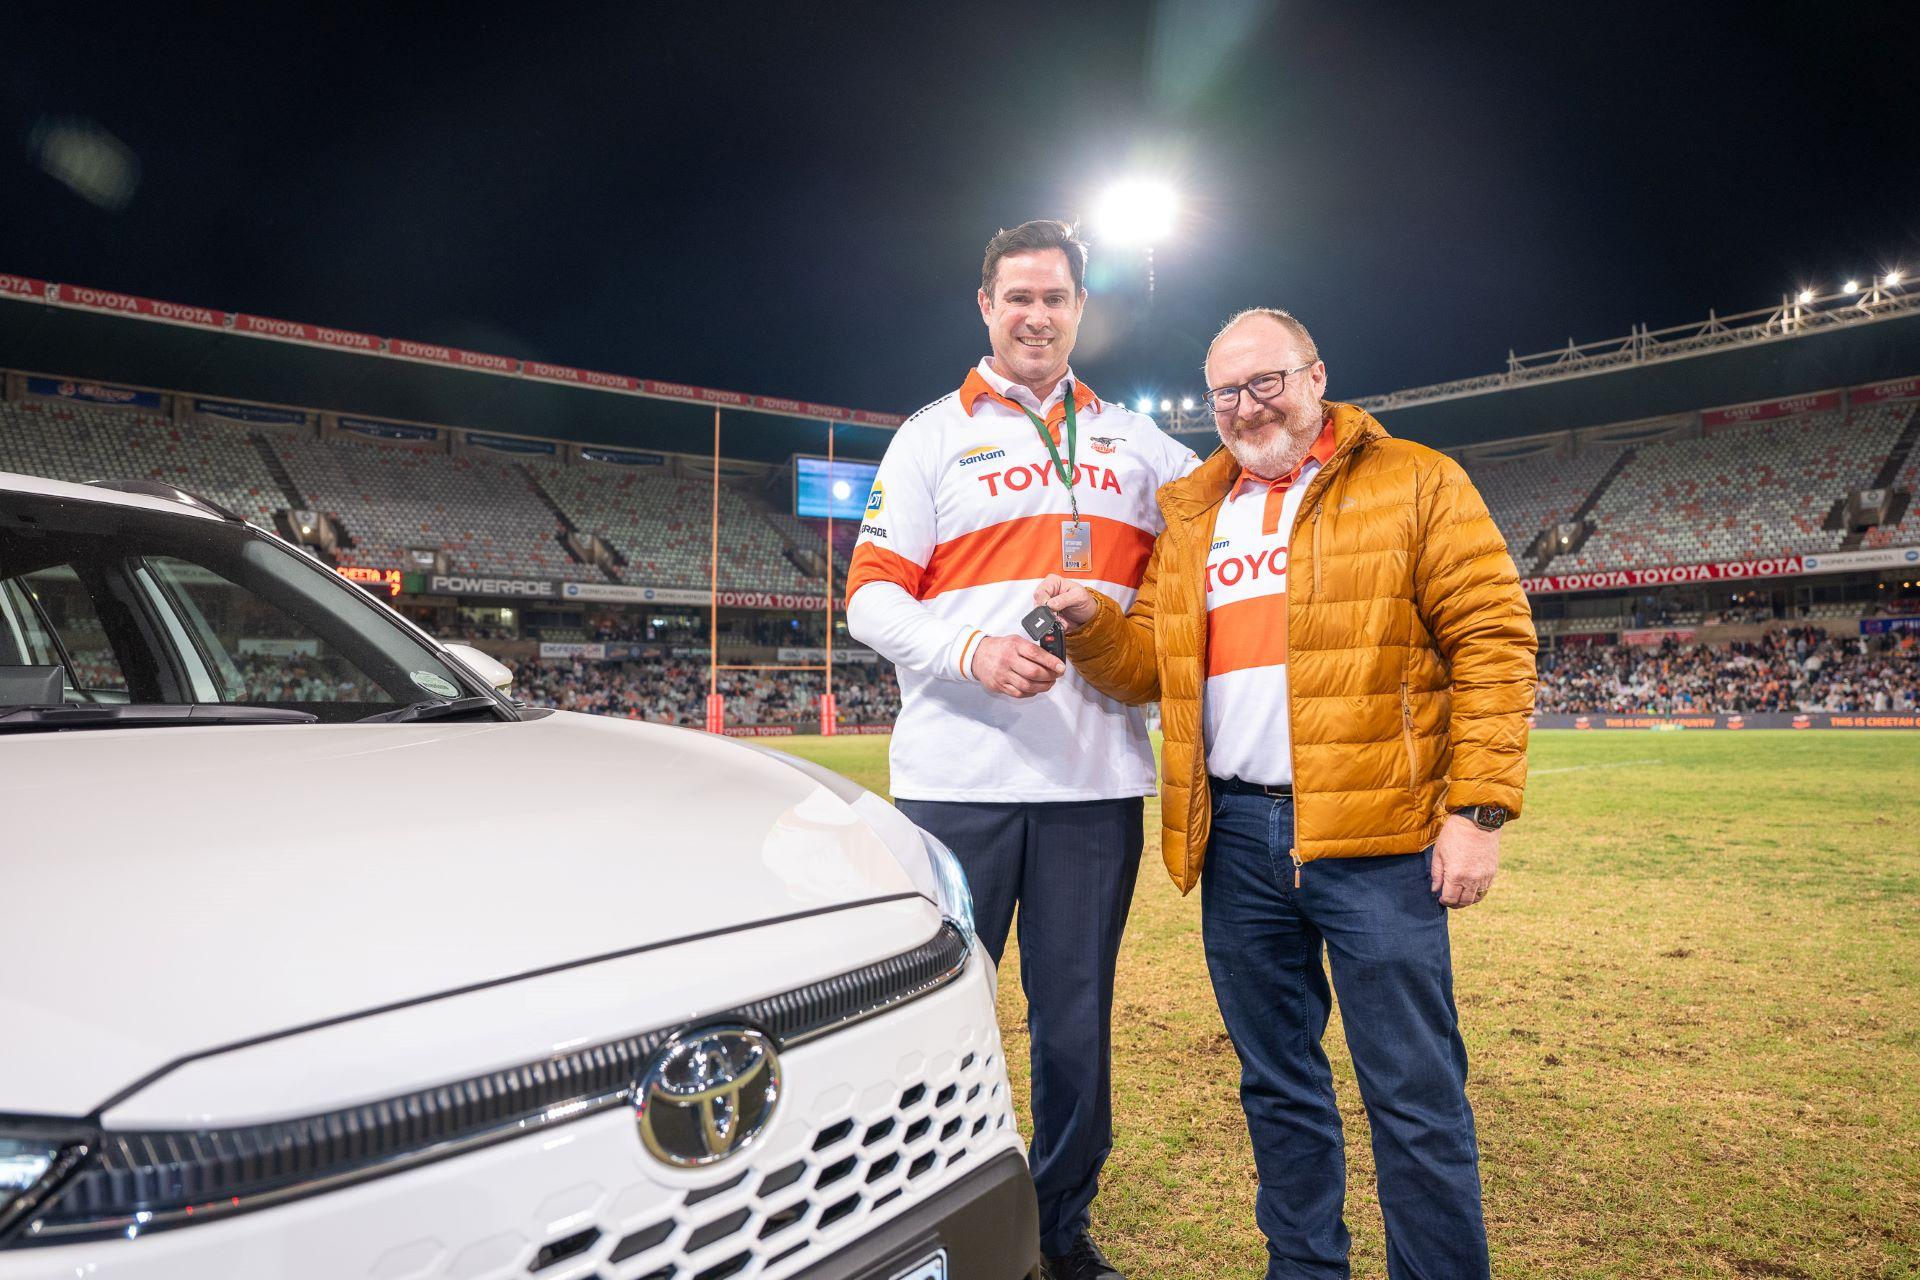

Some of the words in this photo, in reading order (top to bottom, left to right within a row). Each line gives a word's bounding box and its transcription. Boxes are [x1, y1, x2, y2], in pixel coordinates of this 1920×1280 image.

[72, 288, 138, 310] TOYOTA
[152, 302, 213, 323] TOYOTA
[247, 317, 305, 337] TOYOTA
[316, 327, 370, 347] TOYOTA
[400, 342, 450, 360] TOYOTA
[460, 351, 508, 369] TOYOTA
[533, 363, 578, 380] TOYOTA
[586, 372, 628, 388] TOYOTA
[654, 382, 694, 397] TOYOTA
[702, 389, 741, 404] TOYOTA
[763, 398, 800, 412] TOYOTA
[807, 404, 843, 417] TOYOTA
[959, 448, 1006, 467] santam
[978, 459, 1122, 497] TOYOTA
[1556, 571, 1629, 589] TOYOTA
[1632, 565, 1712, 584] TOYOTA
[1715, 557, 1800, 577] TOYOTA
[390, 583, 401, 596] 7
[432, 575, 553, 595] POWERADE
[716, 591, 774, 607] TOYOTA
[777, 594, 828, 609] TOYOTA
[724, 726, 756, 736] OYOTA
